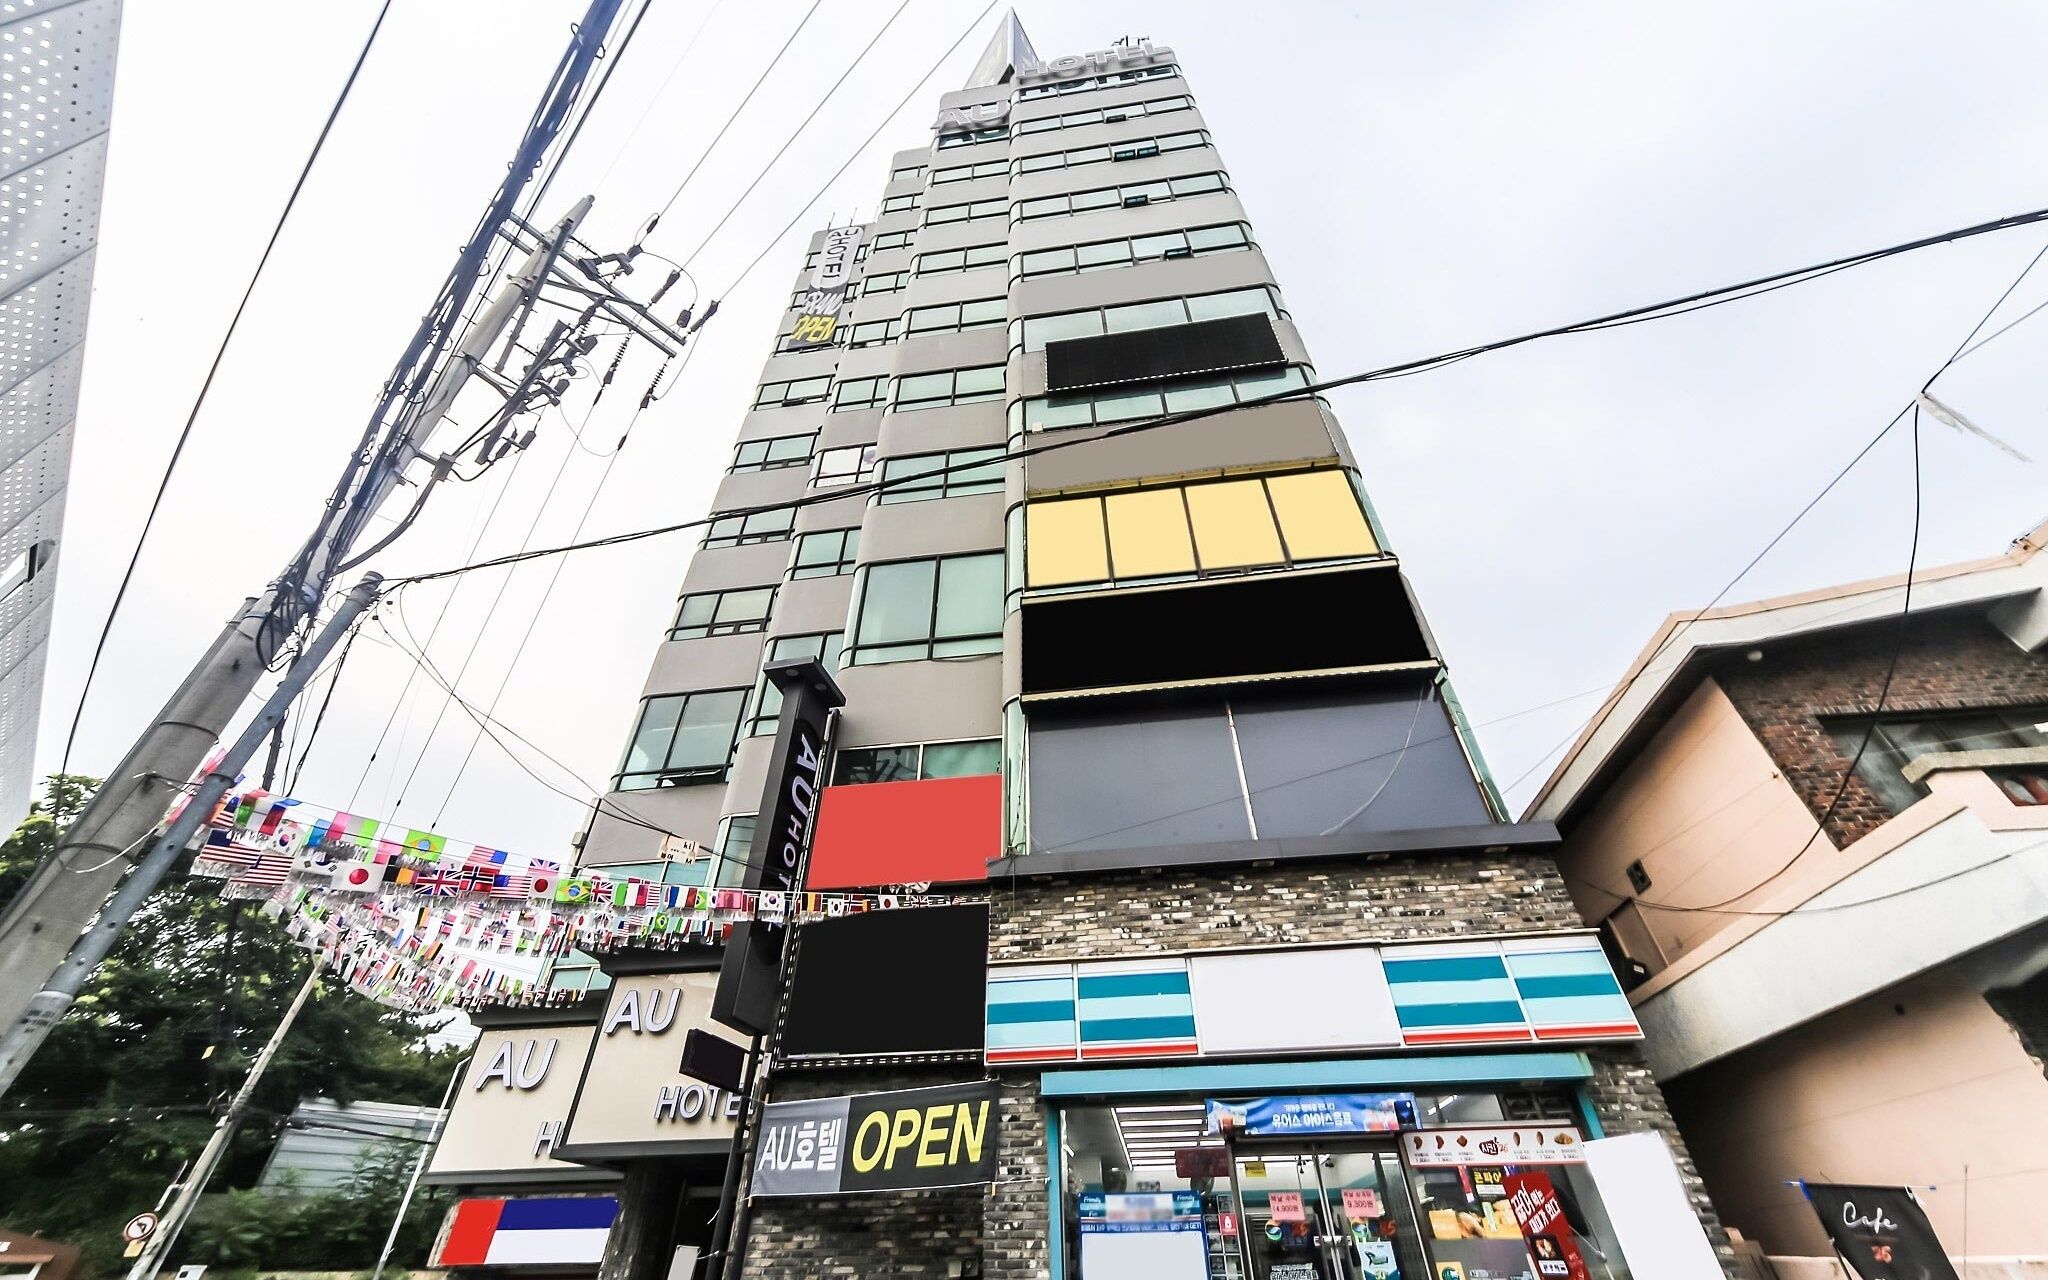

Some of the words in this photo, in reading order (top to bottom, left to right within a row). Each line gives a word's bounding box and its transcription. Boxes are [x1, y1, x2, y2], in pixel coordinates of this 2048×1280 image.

[1015, 42, 1154, 79] HOTEL
[930, 99, 1010, 130] AU
[791, 314, 837, 342] OPEN
[604, 988, 682, 1035] AU
[473, 1038, 559, 1090] AU
[758, 1118, 842, 1172] AU호텔
[852, 1100, 990, 1173] OPEN
[1843, 1201, 1898, 1234] Cafe
